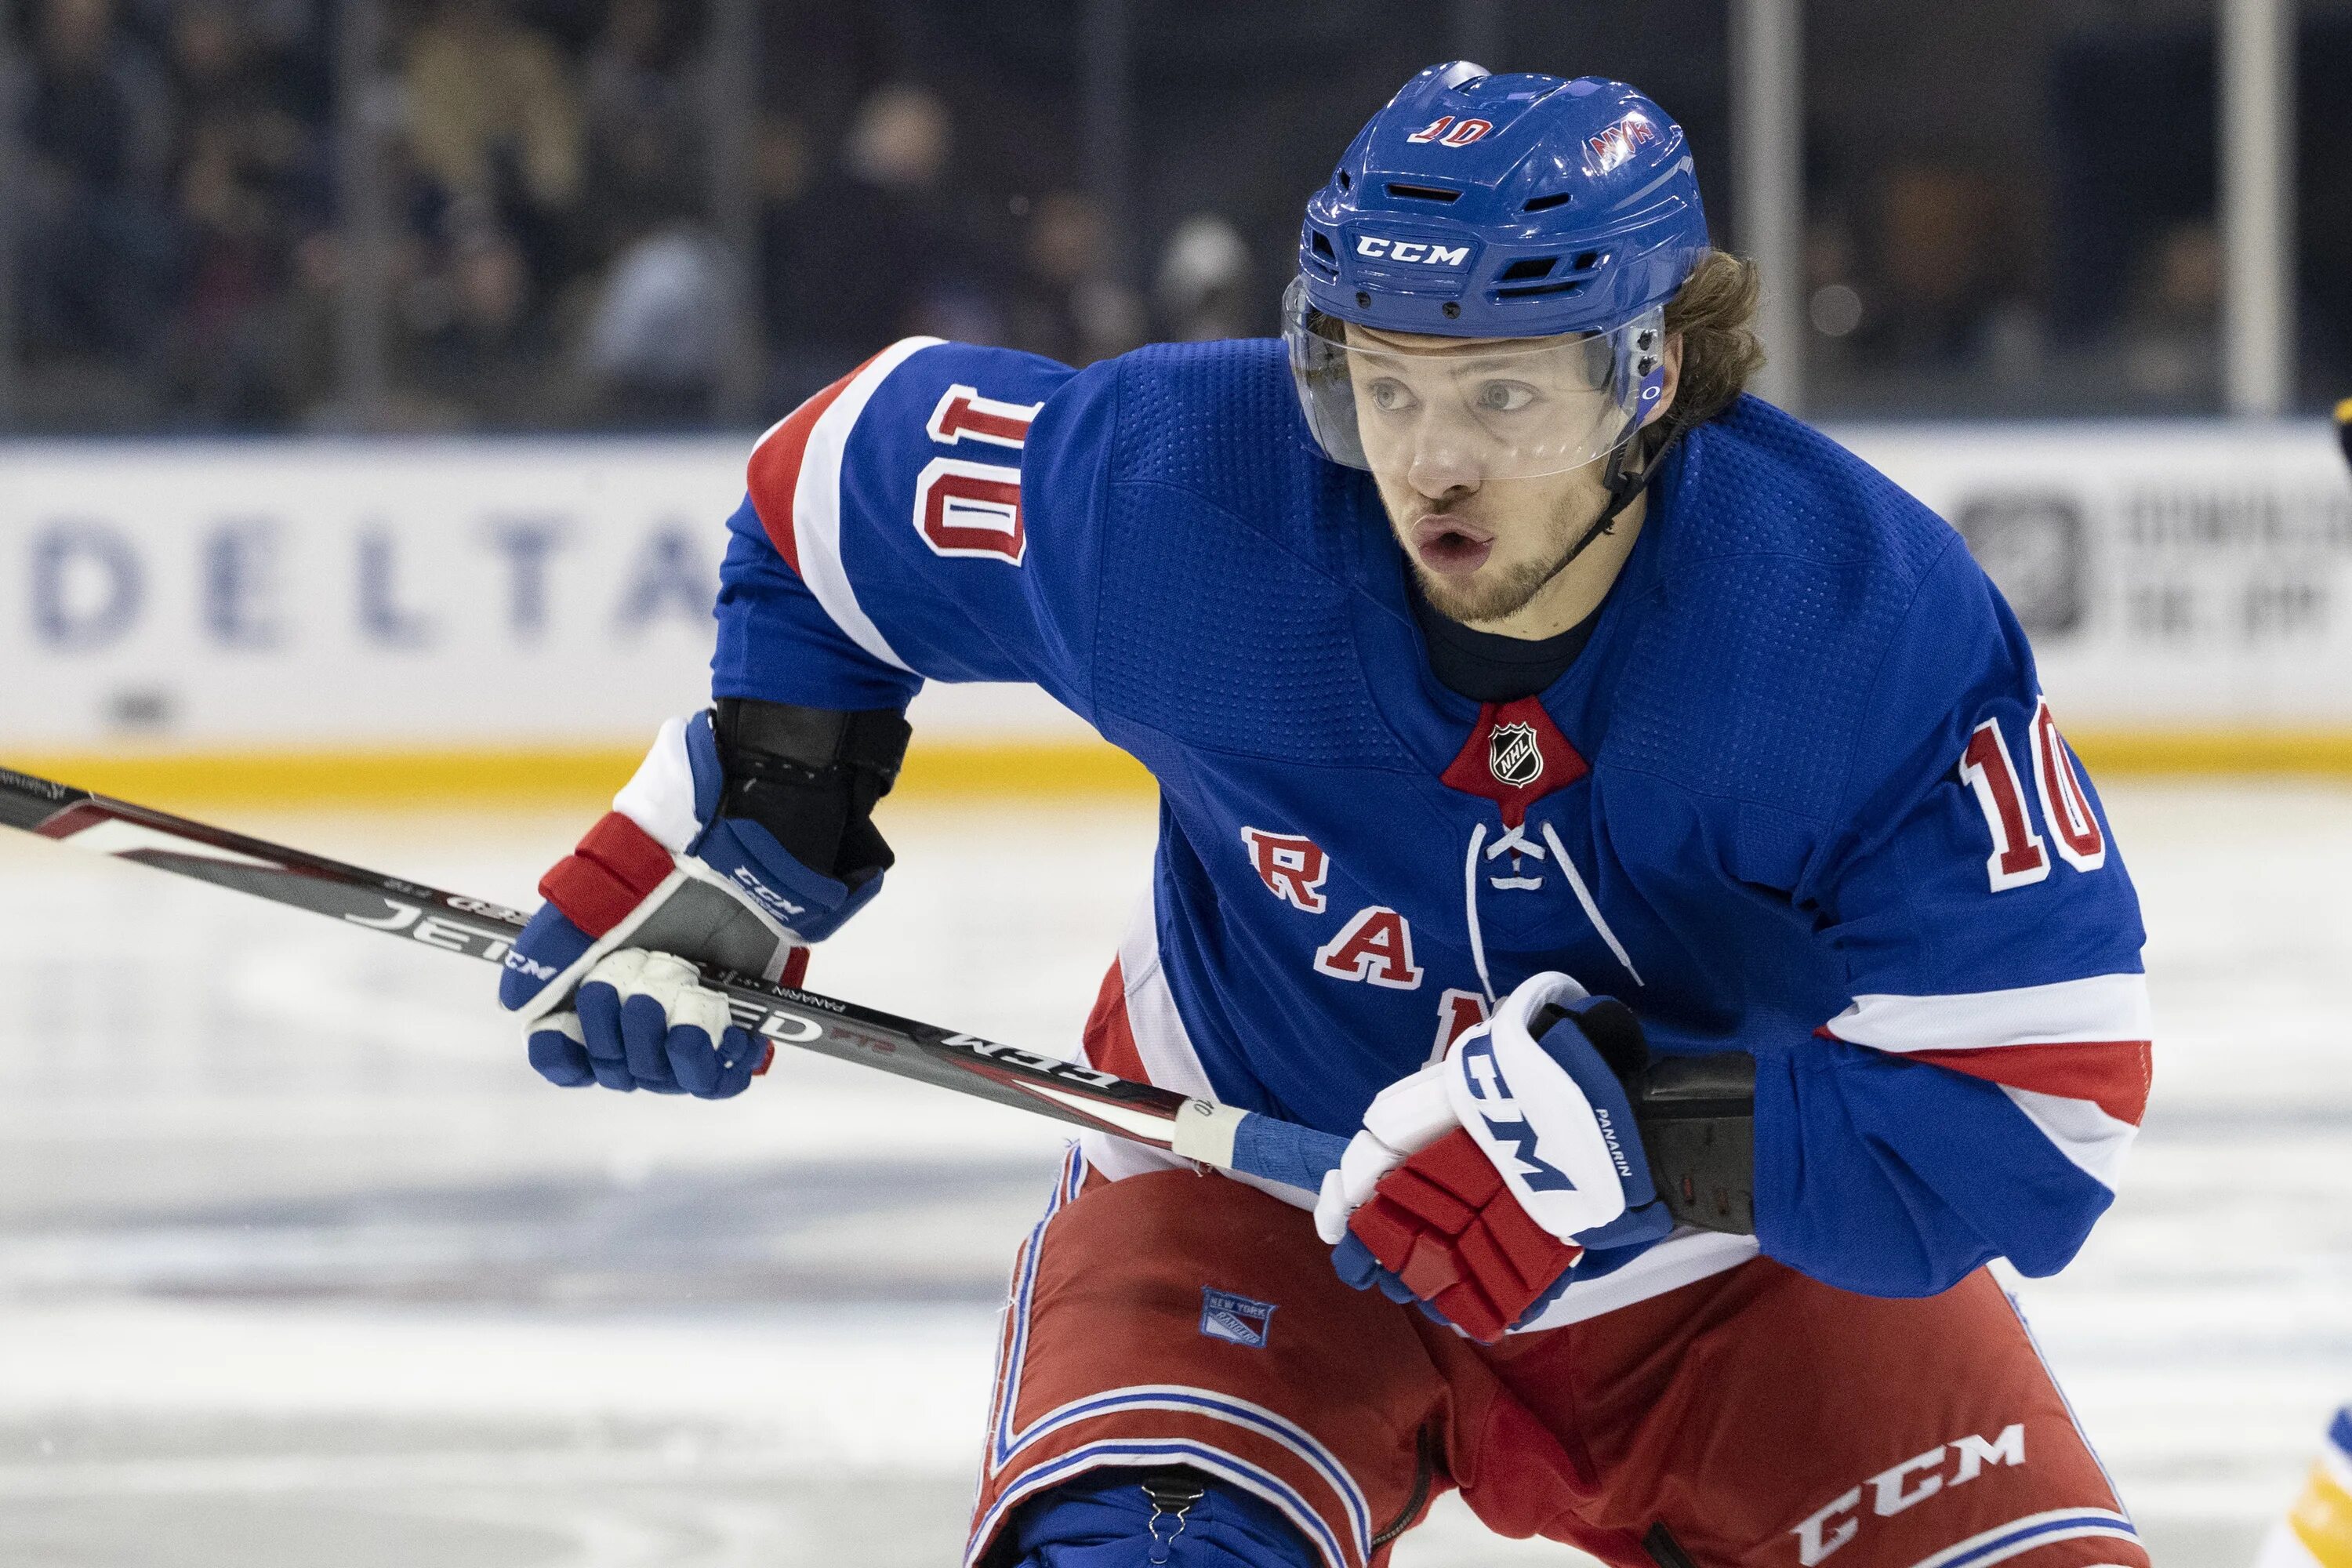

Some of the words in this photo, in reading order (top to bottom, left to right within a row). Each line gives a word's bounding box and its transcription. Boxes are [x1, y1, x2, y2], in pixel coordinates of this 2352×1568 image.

[1407, 116, 1493, 147] 10
[1588, 118, 1655, 161] NYR
[1356, 235, 1470, 267] CCM
[913, 383, 1045, 568] 10
[28, 511, 718, 652] DELTA
[1500, 740, 1530, 775] NHL
[1958, 695, 2106, 893] 10
[735, 866, 805, 916] CCM
[771, 985, 847, 1013] PANARIN
[942, 1033, 1122, 1088] CCM
[1595, 1109, 1632, 1177] PANARIN
[1210, 1298, 1235, 1309] NEW
[1236, 1303, 1266, 1317] YORK
[1215, 1312, 1261, 1344] RANGERS
[1788, 1422, 2026, 1566] CCM
